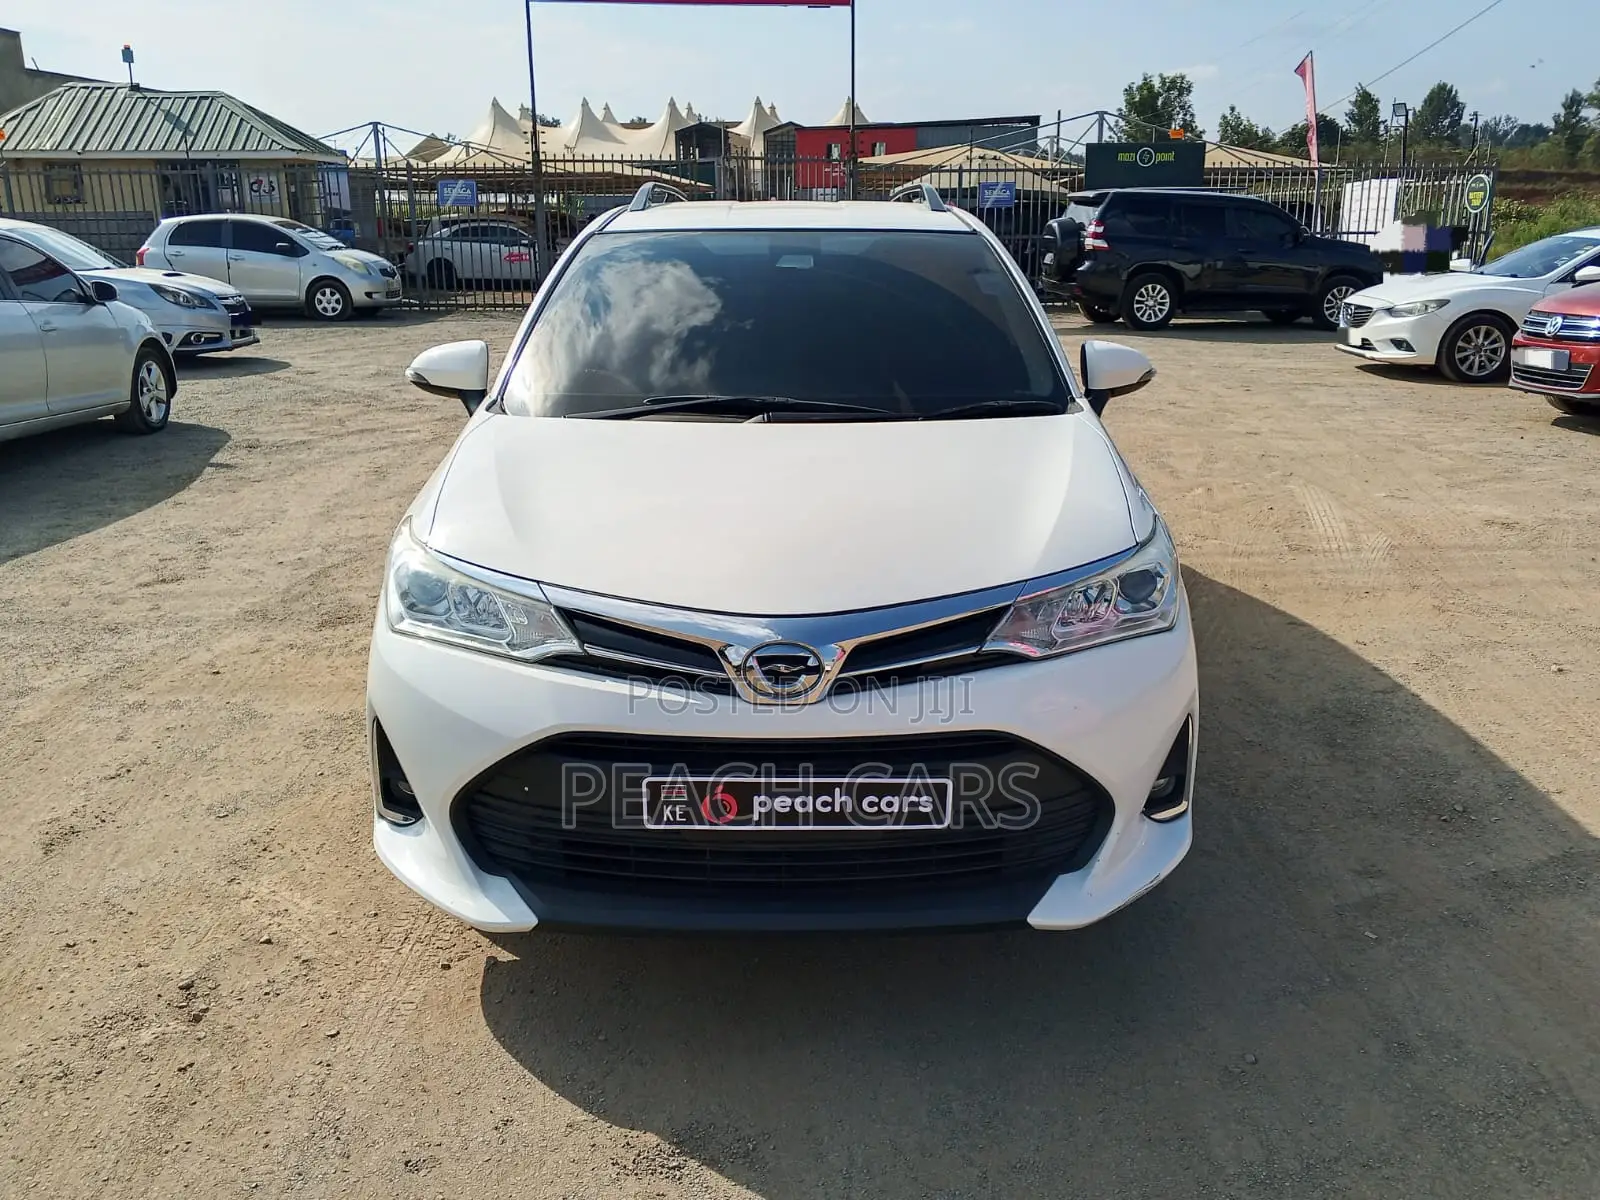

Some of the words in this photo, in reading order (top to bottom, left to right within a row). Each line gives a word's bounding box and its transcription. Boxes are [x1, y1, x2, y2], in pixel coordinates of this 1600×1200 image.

[1155, 150, 1175, 164] point
[753, 787, 853, 821] peach
[862, 795, 934, 813] cars
[663, 805, 687, 821] KE
